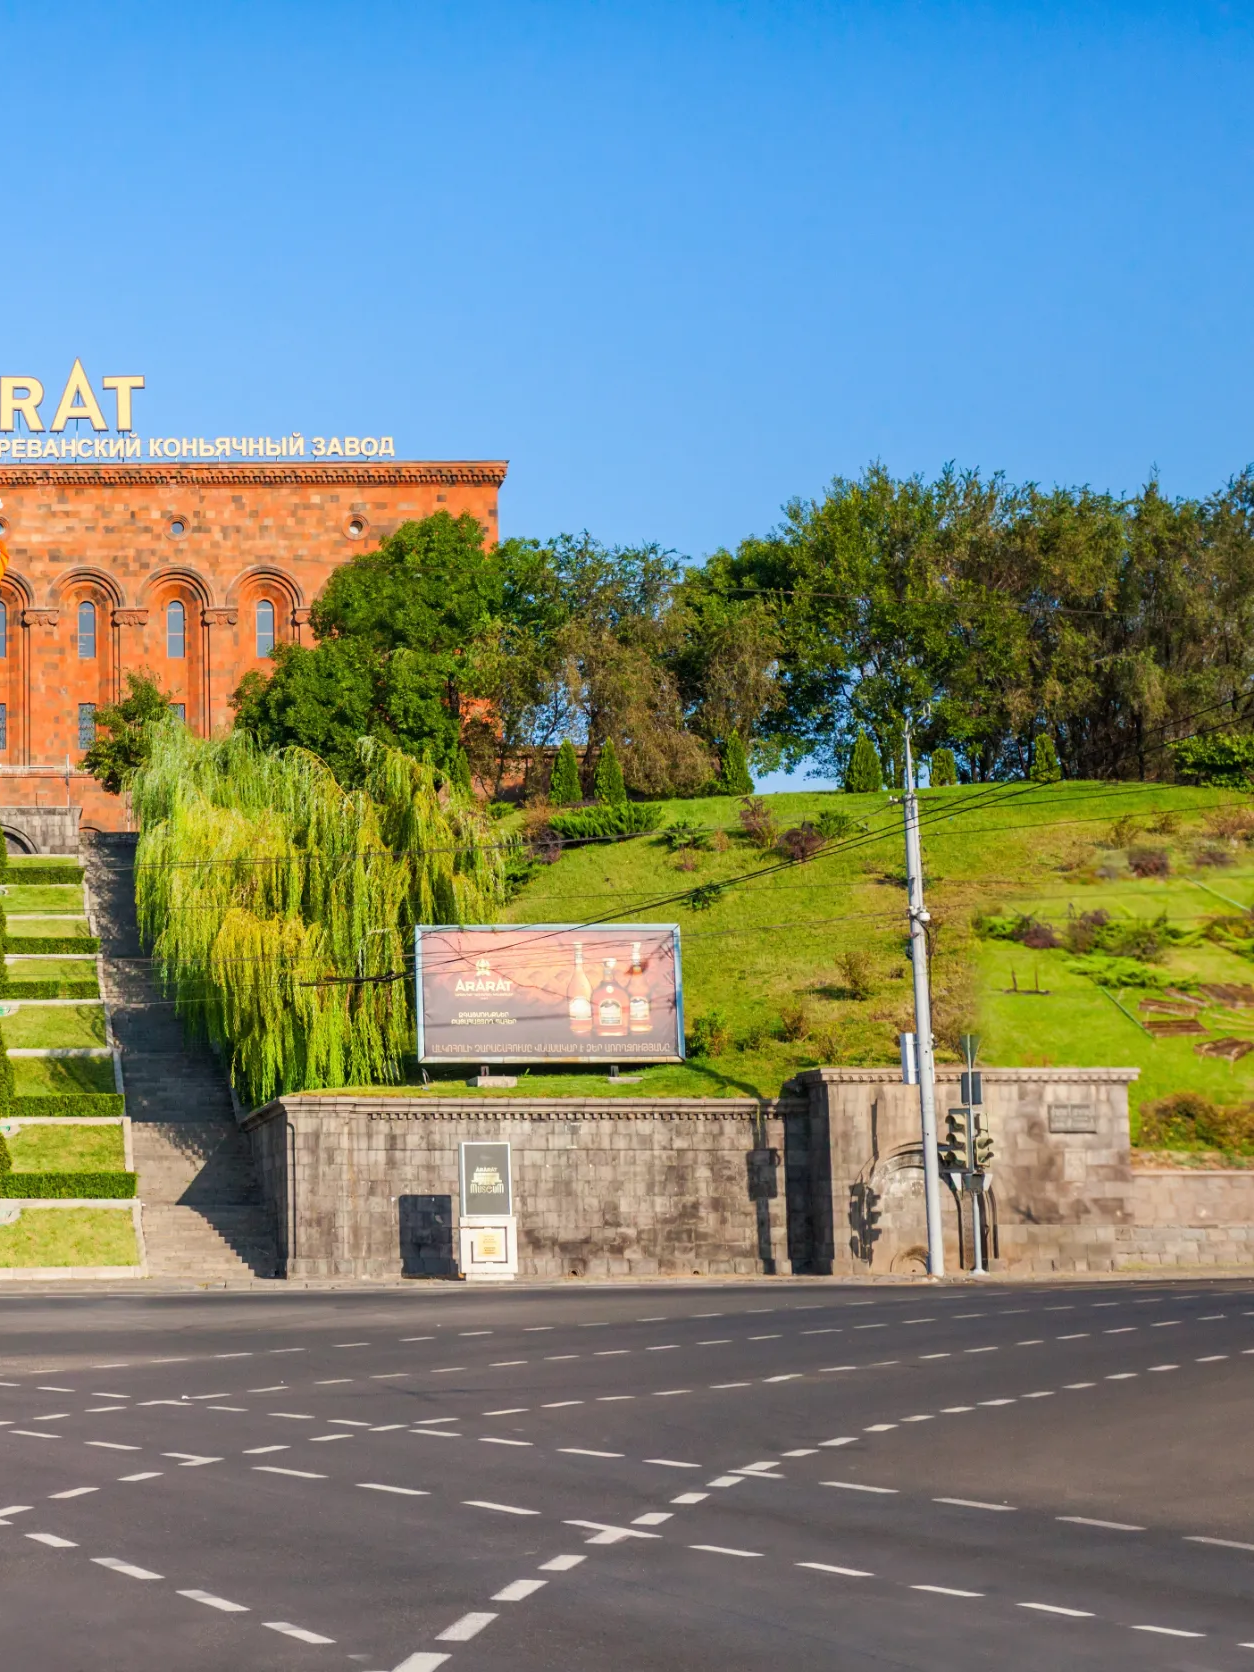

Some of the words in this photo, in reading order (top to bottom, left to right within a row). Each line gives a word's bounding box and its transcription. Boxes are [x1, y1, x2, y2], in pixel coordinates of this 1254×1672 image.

[149, 432, 306, 457] КОНЬЯЧНЫЙ
[311, 436, 395, 457] ЗАВОД
[455, 977, 513, 992] ARARAT
